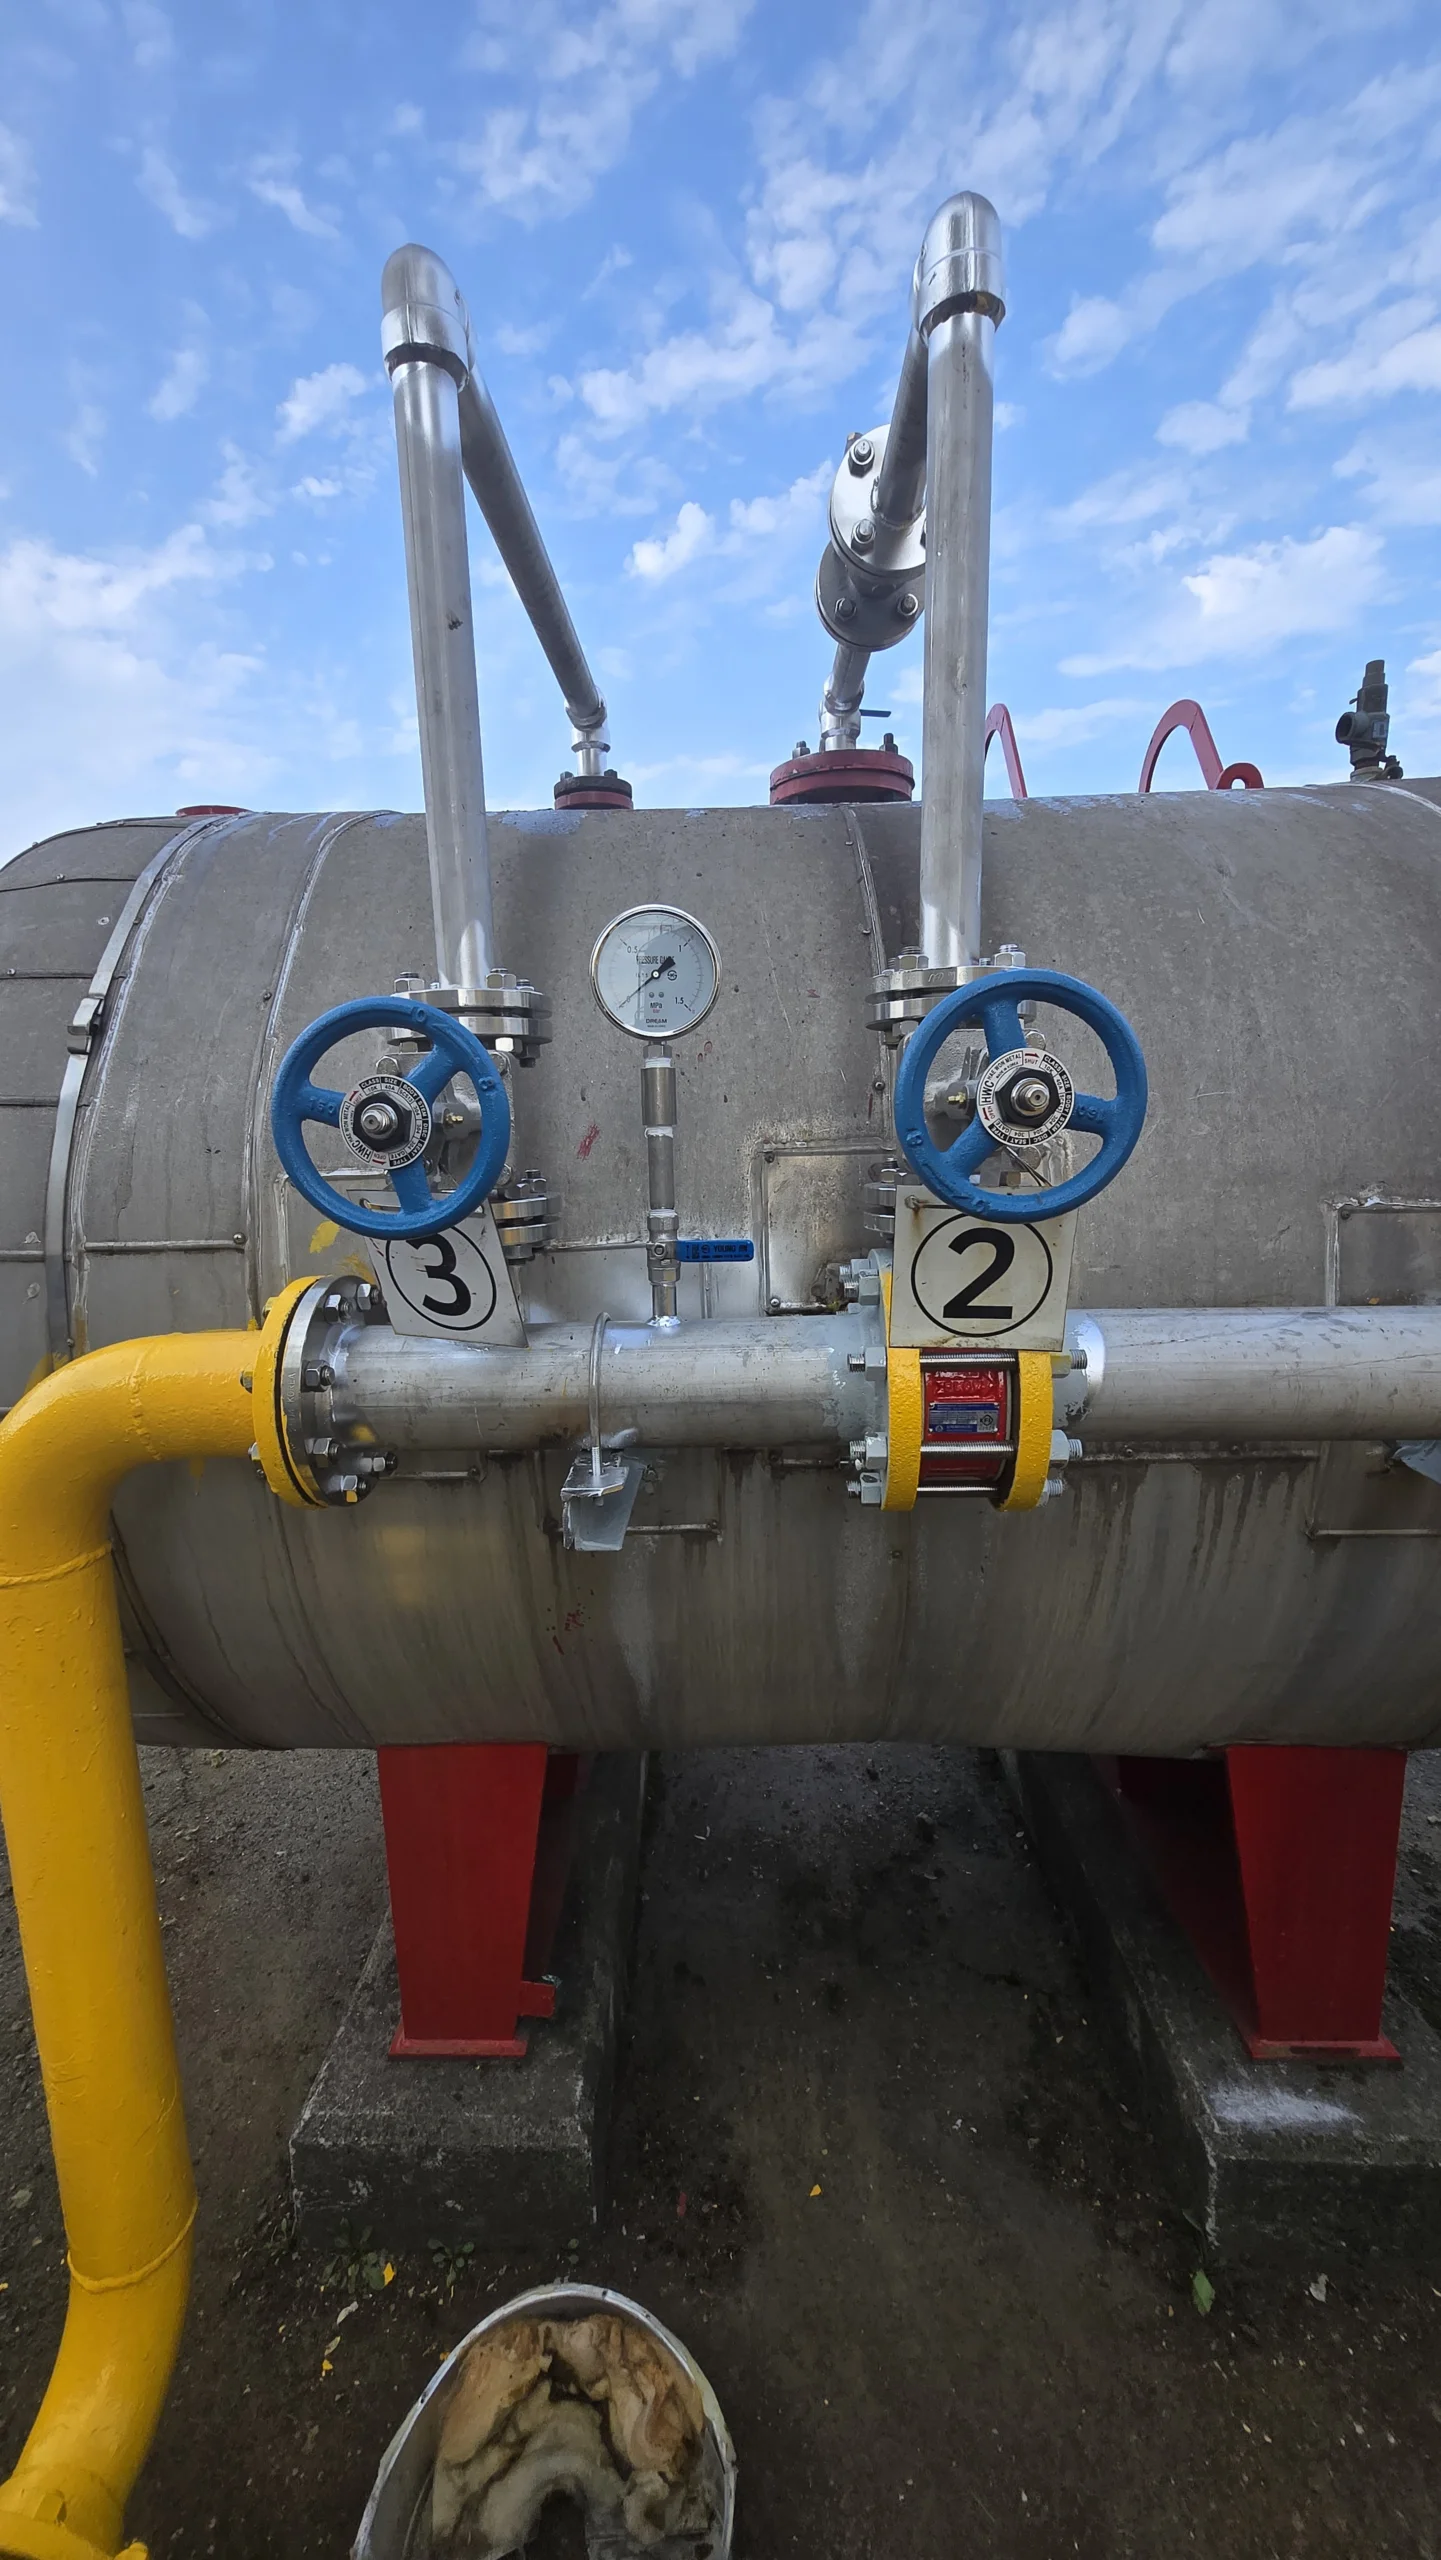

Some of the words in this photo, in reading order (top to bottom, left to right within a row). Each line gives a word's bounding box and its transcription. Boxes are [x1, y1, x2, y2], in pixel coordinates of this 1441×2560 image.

[995, 1061, 1005, 1071] WON
[1005, 1053, 1021, 1063] METAL
[1044, 1056, 1062, 1072] CLASS
[361, 1078, 380, 1088] CLASS
[1062, 1075, 1071, 1089] SIZE
[403, 1084, 417, 1097] BODY
[982, 1081, 994, 1103] HWC
[343, 1104, 351, 1120] METAL
[418, 1101, 427, 1117] STEM
[987, 1106, 995, 1119] OPEN
[996, 1121, 1010, 1133] GATE
[1052, 1117, 1065, 1132] STEM
[991, 1127, 1005, 1139] TYPE
[1033, 1134, 1049, 1142] DISC
[352, 1140, 372, 1160] HWC
[391, 1150, 406, 1159] GATE
[411, 1142, 422, 1156] SEAT
[393, 1158, 408, 1166] TYPE
[406, 1234, 471, 1316] 3
[943, 1227, 1015, 1319] 2
